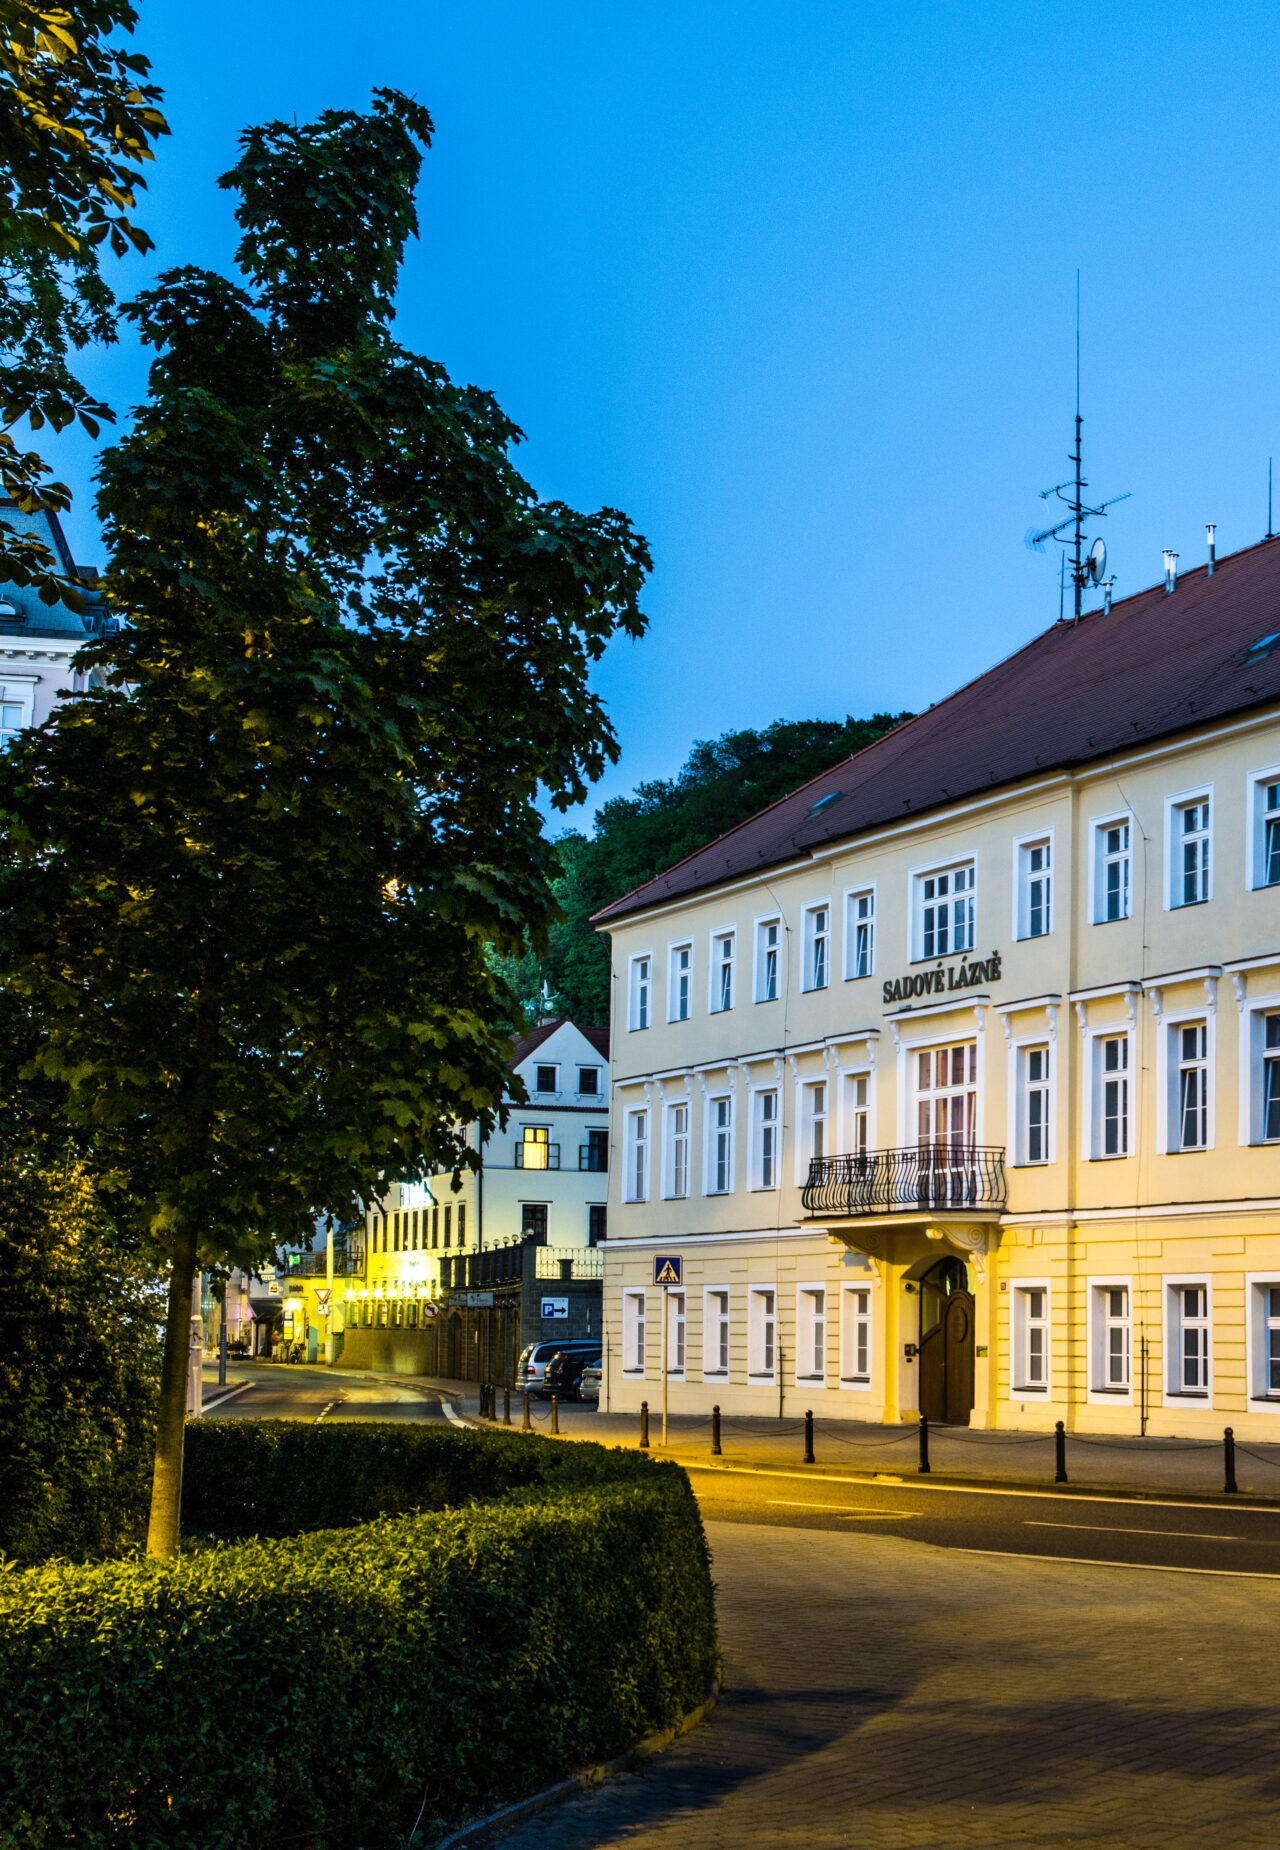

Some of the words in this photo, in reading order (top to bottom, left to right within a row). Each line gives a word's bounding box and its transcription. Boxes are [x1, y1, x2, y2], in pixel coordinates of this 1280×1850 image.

[883, 961, 945, 1003] SADOVÉ
[947, 950, 1002, 991] LÁZNĚ
[544, 1305, 553, 1315] P
